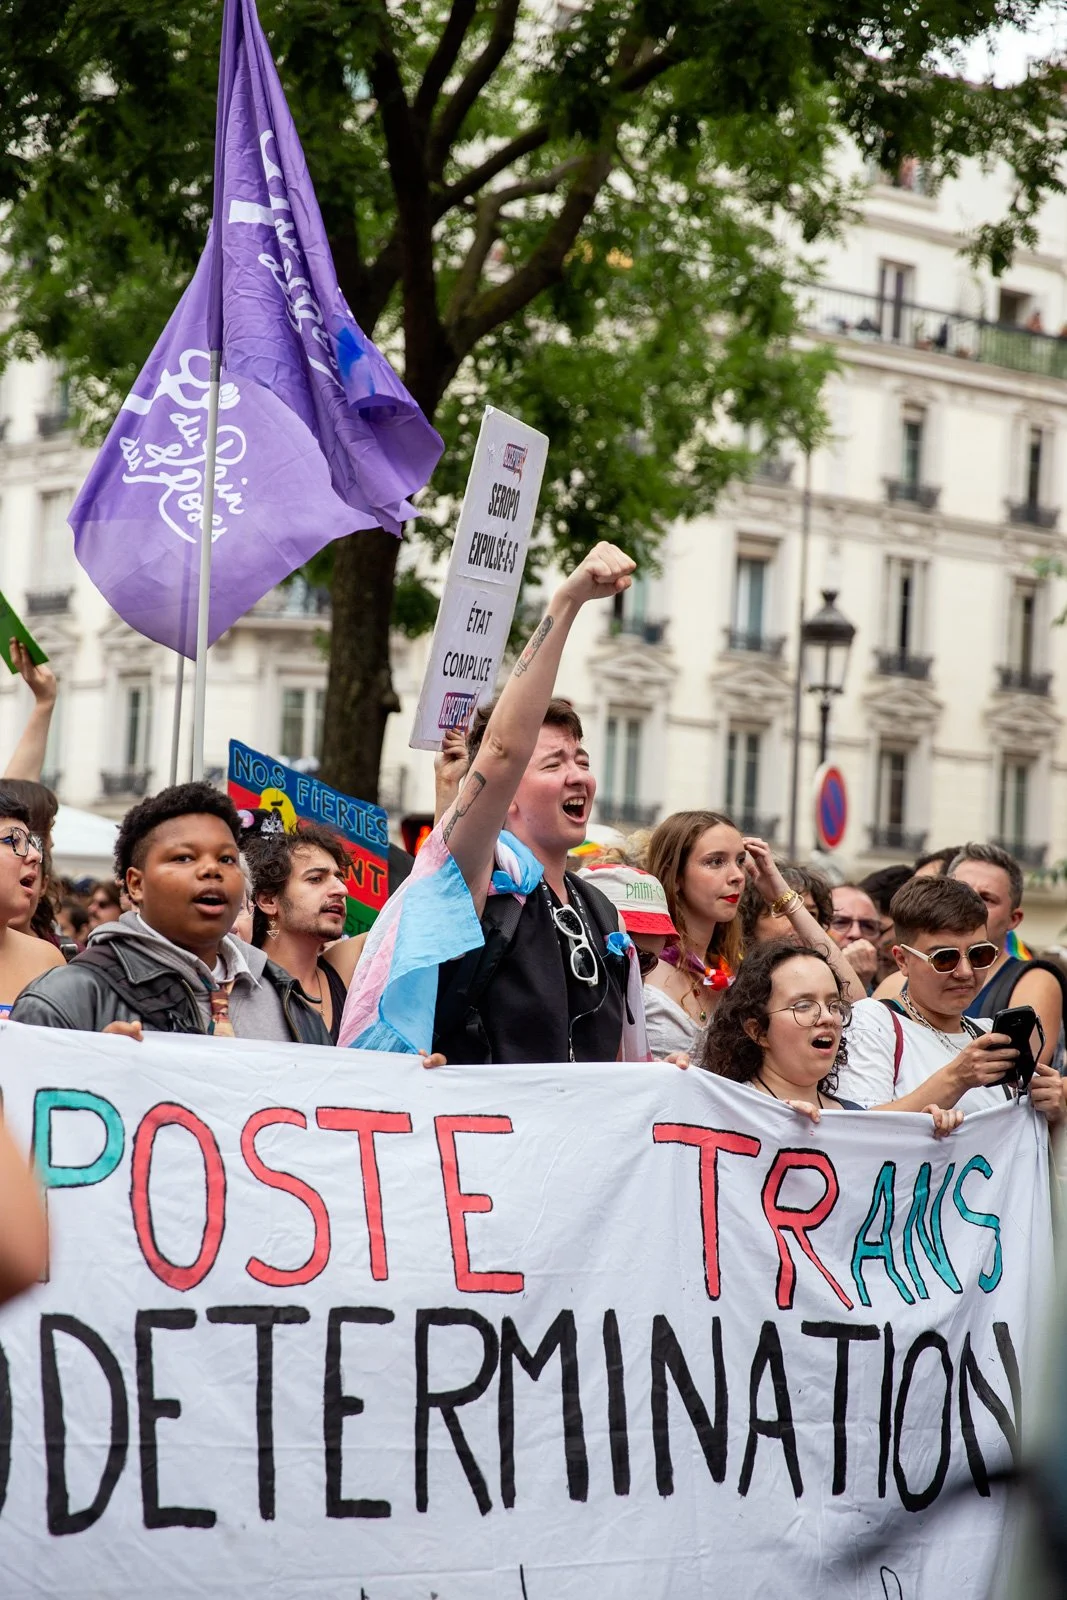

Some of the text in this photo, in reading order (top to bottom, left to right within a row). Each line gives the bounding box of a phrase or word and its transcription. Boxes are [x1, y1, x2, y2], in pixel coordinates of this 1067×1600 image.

[488, 482, 521, 523] SEROPO
[466, 600, 493, 636] ÉTAT
[442, 651, 493, 682] COMPLICE
[233, 747, 287, 792] NOS
[343, 857, 387, 897] NT
[0, 1086, 1004, 1311] POSTE TRANS
[0, 1305, 1023, 1537] DETERMINATION
